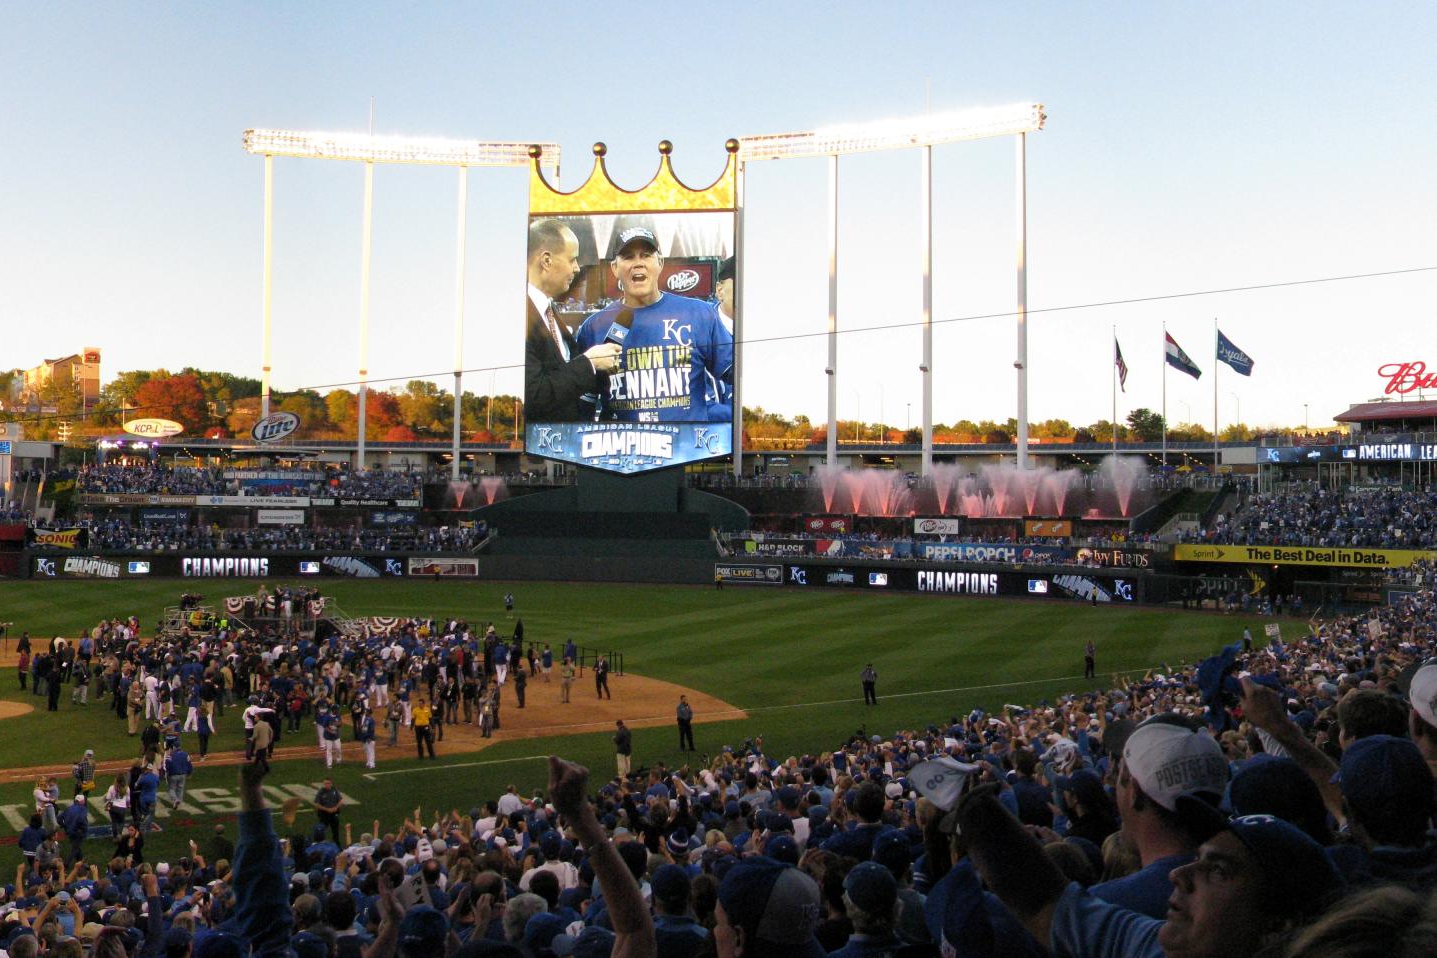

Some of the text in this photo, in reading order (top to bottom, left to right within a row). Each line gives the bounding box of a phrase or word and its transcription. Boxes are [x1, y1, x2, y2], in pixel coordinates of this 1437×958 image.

[662, 319, 692, 346] KC
[626, 346, 664, 371] OWN
[666, 344, 692, 368] THE
[609, 368, 692, 400] PENNANT
[260, 420, 294, 441] Lite
[576, 423, 633, 433] AMERICAN
[581, 432, 674, 458] CHAMPIONS
[1359, 444, 1411, 460] AMERICAN
[37, 534, 78, 544] SONIC
[925, 545, 962, 560] PEPSI
[1193, 550, 1214, 560] Sprint
[1246, 548, 1390, 565] The Best Deal in Data.
[37, 558, 55, 576] KC
[63, 558, 121, 578] CHAMPIONS
[182, 557, 269, 577] CHAMPIONS
[385, 559, 402, 576] KC
[790, 566, 806, 584] KC
[917, 570, 998, 595] CHAMPIONS
[1114, 579, 1132, 600] KC
